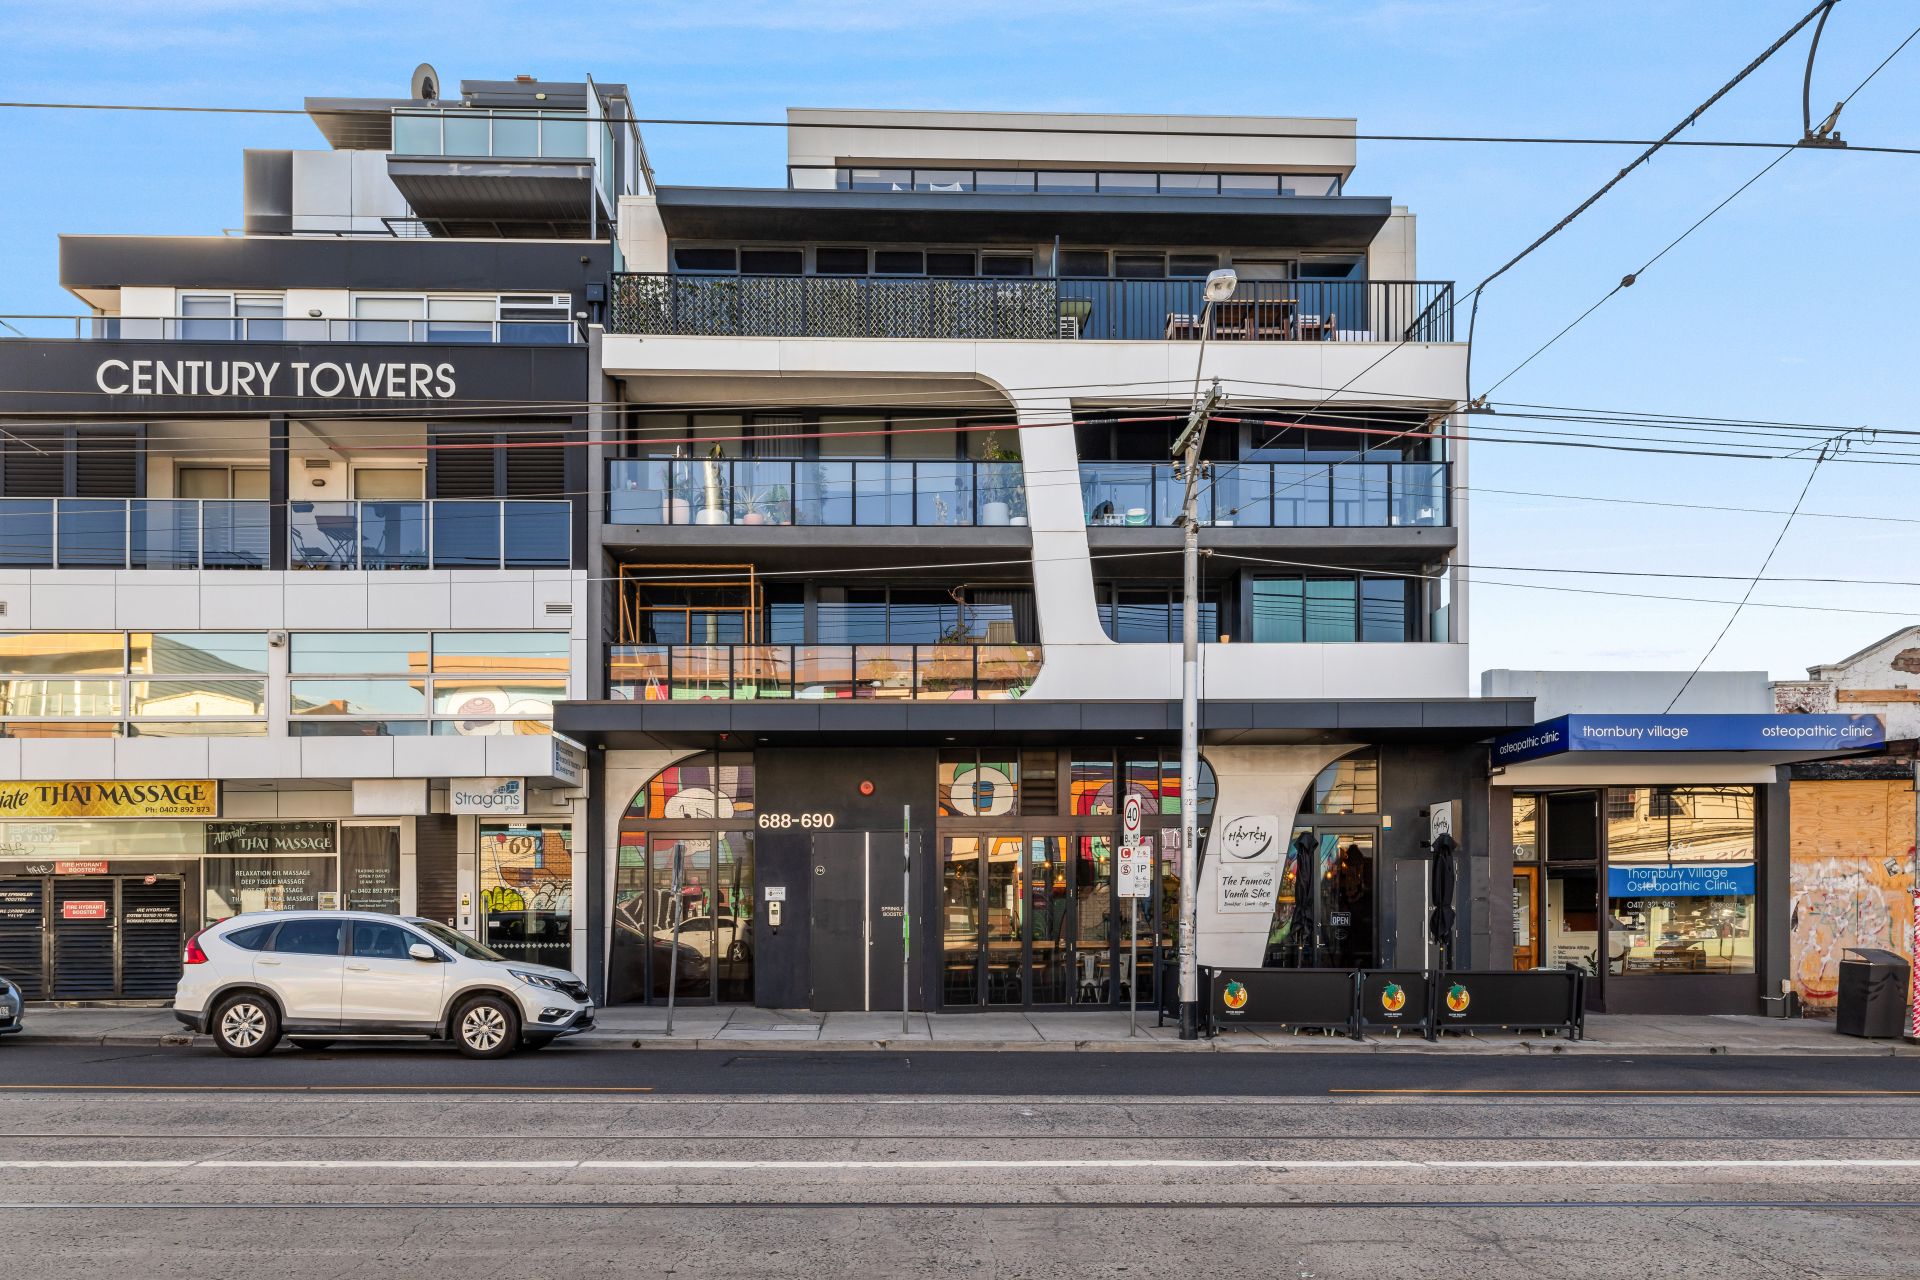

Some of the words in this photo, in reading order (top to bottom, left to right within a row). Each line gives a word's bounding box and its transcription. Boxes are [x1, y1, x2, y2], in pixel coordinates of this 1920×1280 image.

[96, 359, 281, 396] CENTURY
[291, 362, 456, 398] TOWERS
[1582, 725, 1644, 739] thornbury
[1647, 725, 1689, 739] village
[1762, 725, 1837, 739] osteopathic
[1840, 725, 1873, 737] clinic
[1499, 736, 1540, 755] osteopathic
[1540, 730, 1560, 745] clinic
[34, 782, 92, 806] THAI
[95, 784, 206, 806] MASSAGE
[455, 791, 520, 809] Stragans
[758, 813, 835, 829] 688-690
[1127, 807, 1138, 822] 40
[213, 824, 247, 846] Alleviate
[1228, 830, 1267, 842] HAYTCH
[238, 837, 269, 850] THAI
[274, 837, 332, 851] MASSAGE
[508, 836, 544, 855] 692
[1626, 868, 1684, 880] Thornbury
[1688, 867, 1728, 880] Village
[1222, 876, 1238, 886] The
[1240, 876, 1272, 886] Famous
[1626, 880, 1701, 893] Osteopathic
[1704, 879, 1738, 891] Clinic
[1250, 888, 1271, 899] Slice
[1332, 916, 1349, 925] OPEN
